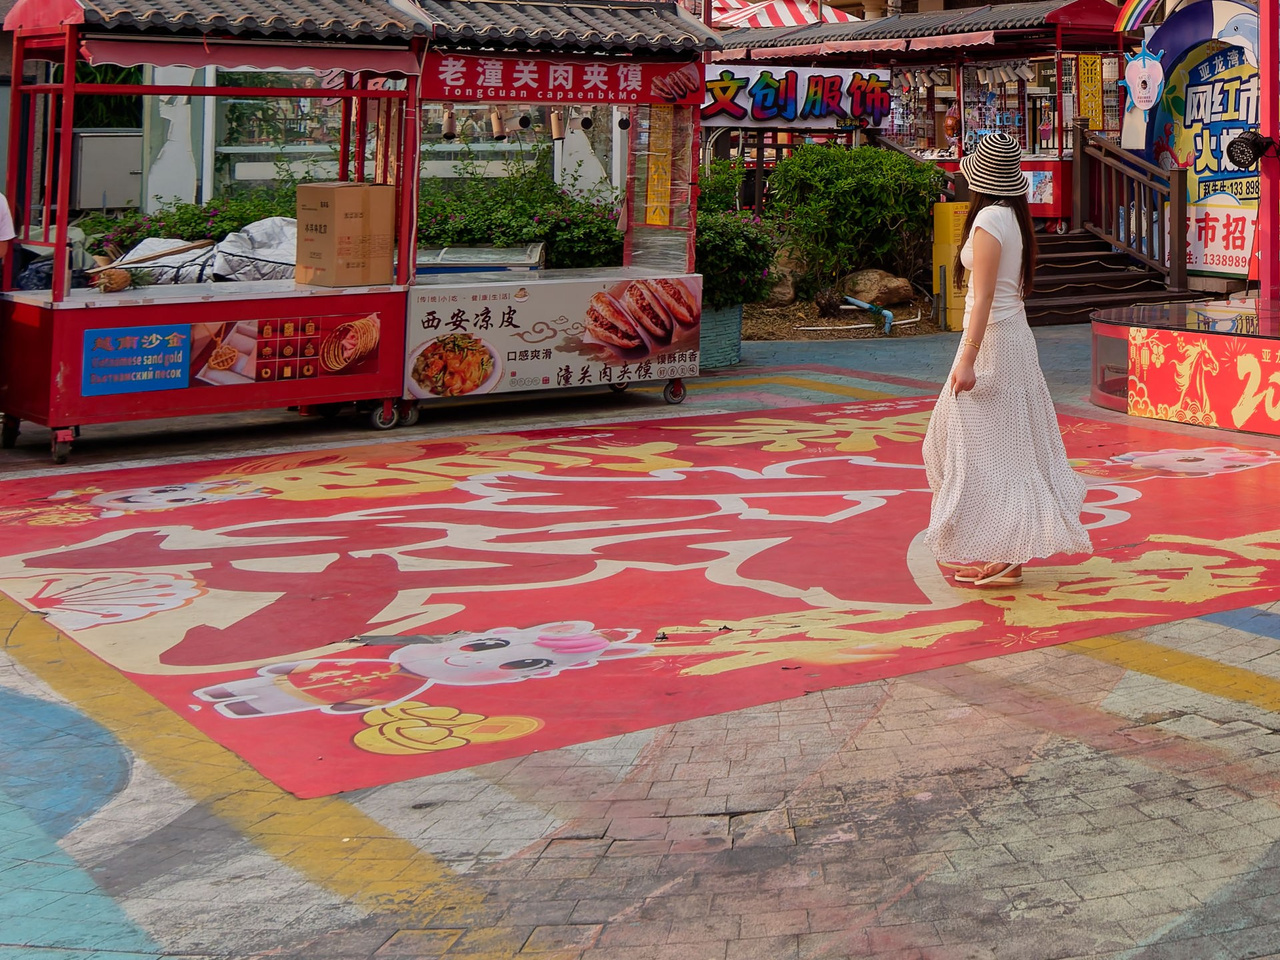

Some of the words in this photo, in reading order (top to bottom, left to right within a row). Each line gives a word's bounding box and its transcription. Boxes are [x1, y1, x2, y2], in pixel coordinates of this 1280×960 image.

[438, 57, 643, 91] 老潼关肉夹馍
[444, 86, 527, 99] TongGuan
[537, 90, 638, 101] capaenbkMo
[701, 70, 891, 127] 文创服饰
[1168, 212, 1257, 251] 市招
[1203, 253, 1251, 267] 1338989
[421, 306, 521, 332] 西安凉皮
[143, 352, 163, 365] sand
[164, 350, 183, 367] gold
[507, 349, 552, 361] 口感爽滑
[656, 353, 698, 366] 馍酥肉香
[557, 362, 653, 387] 潼关肉夹馍
